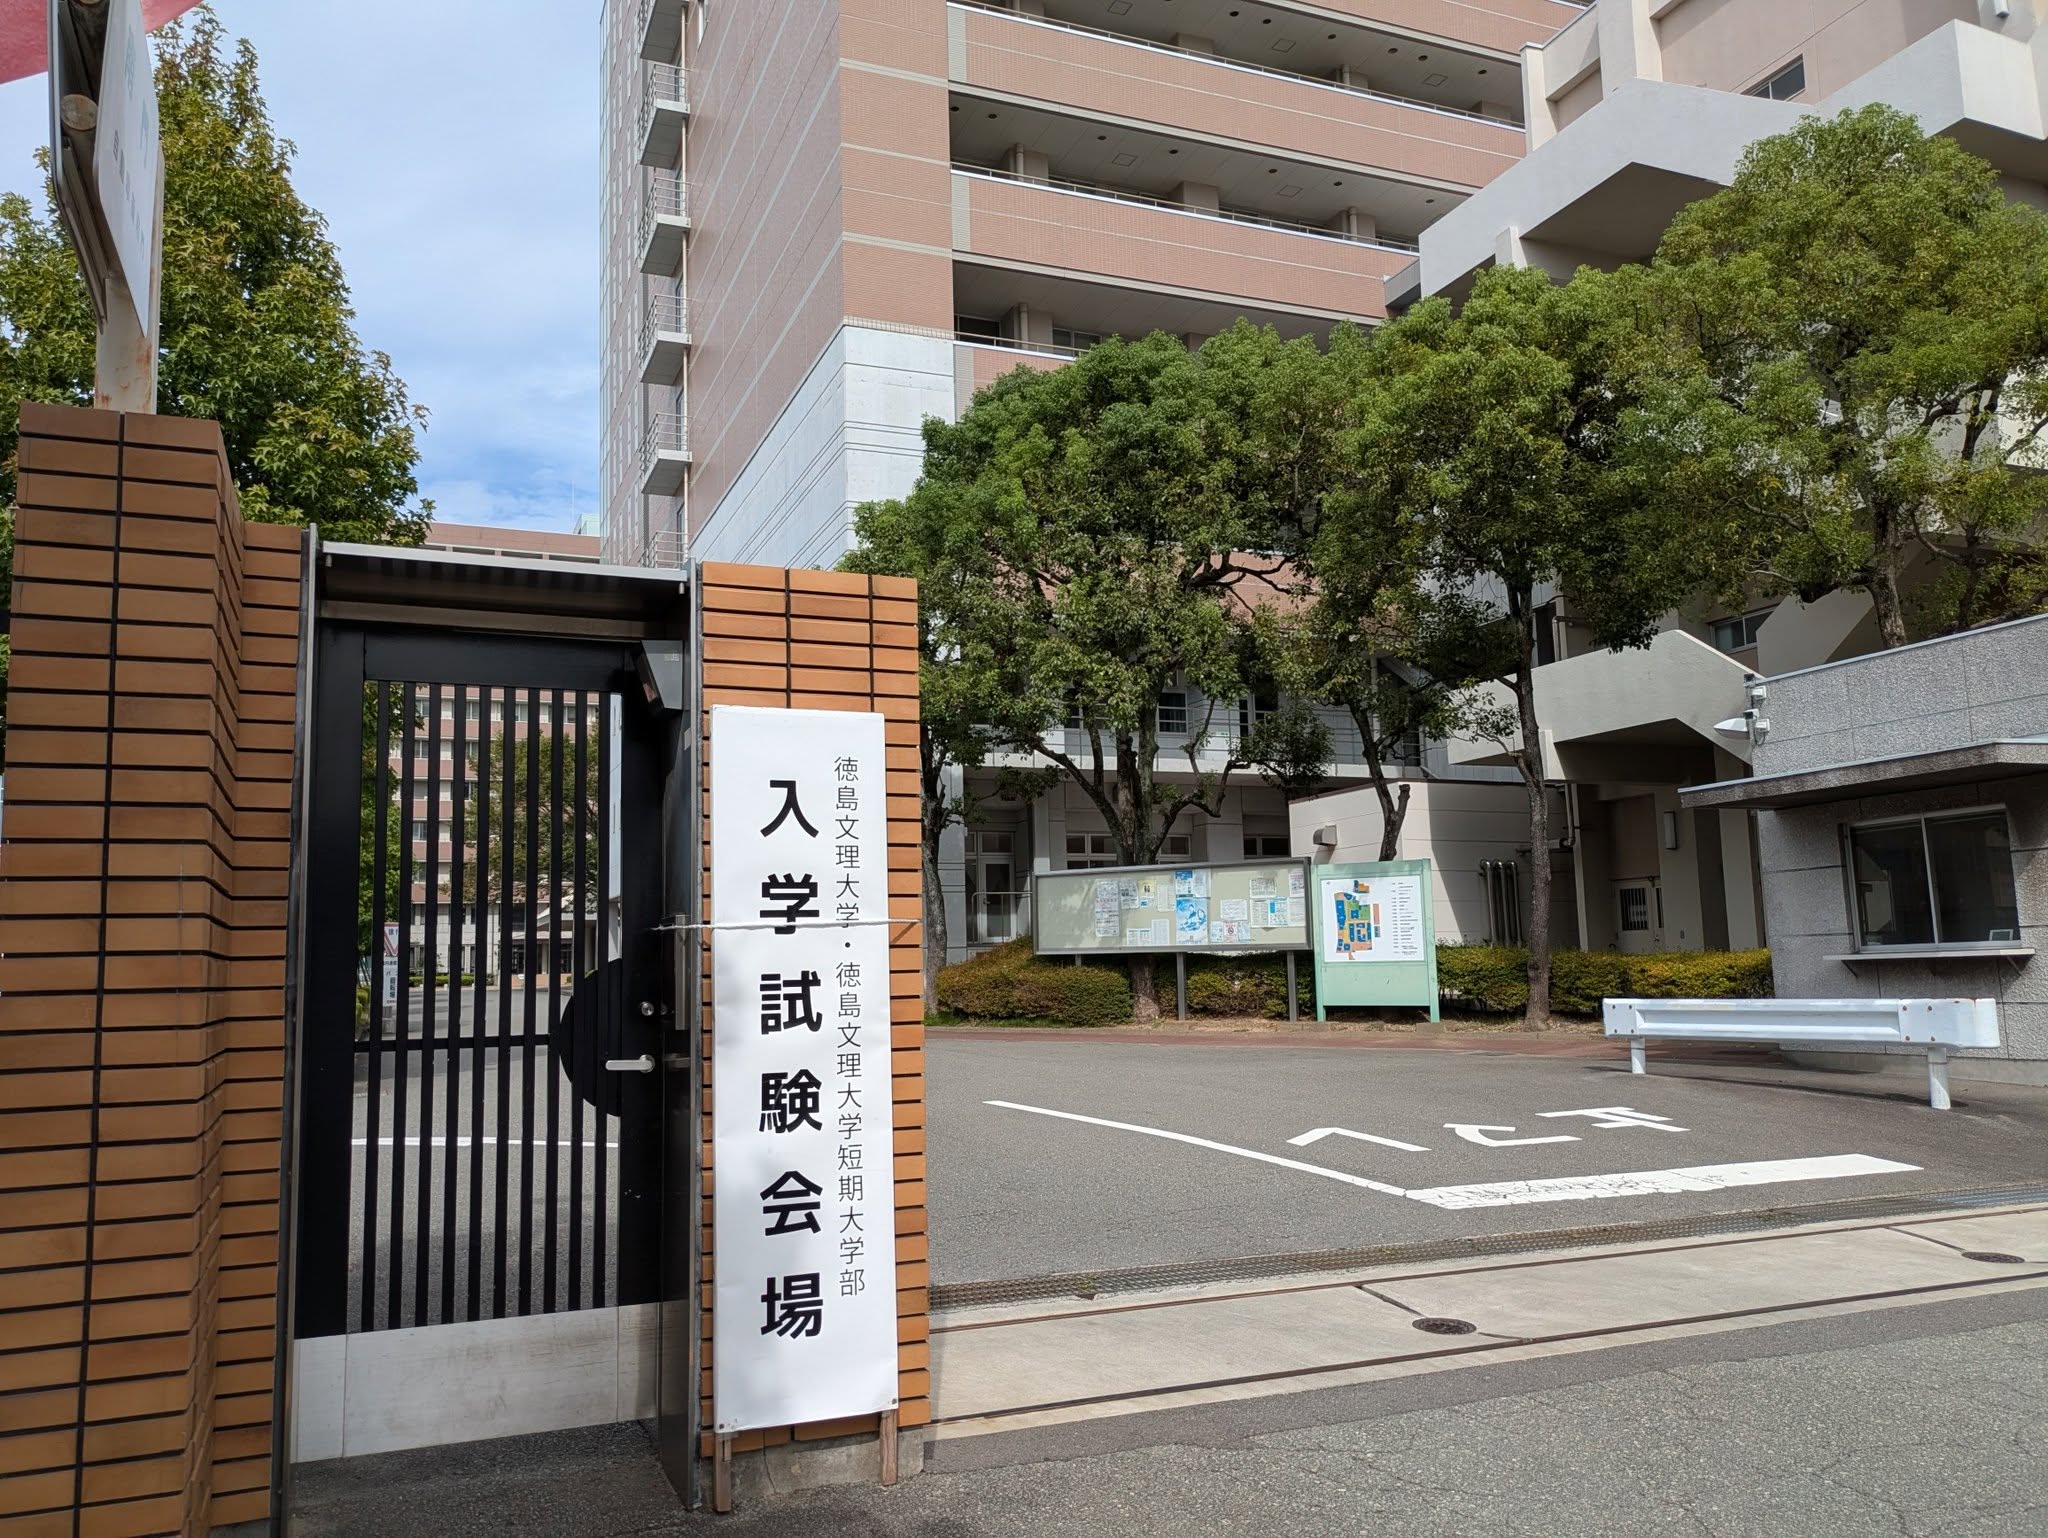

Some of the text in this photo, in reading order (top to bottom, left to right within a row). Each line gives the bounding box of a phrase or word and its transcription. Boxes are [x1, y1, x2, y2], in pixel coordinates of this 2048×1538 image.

[759, 779, 824, 1339] 入学試験会場
[834, 756, 865, 1297] 徳島文理大学・徳島文理大学短期大学部
